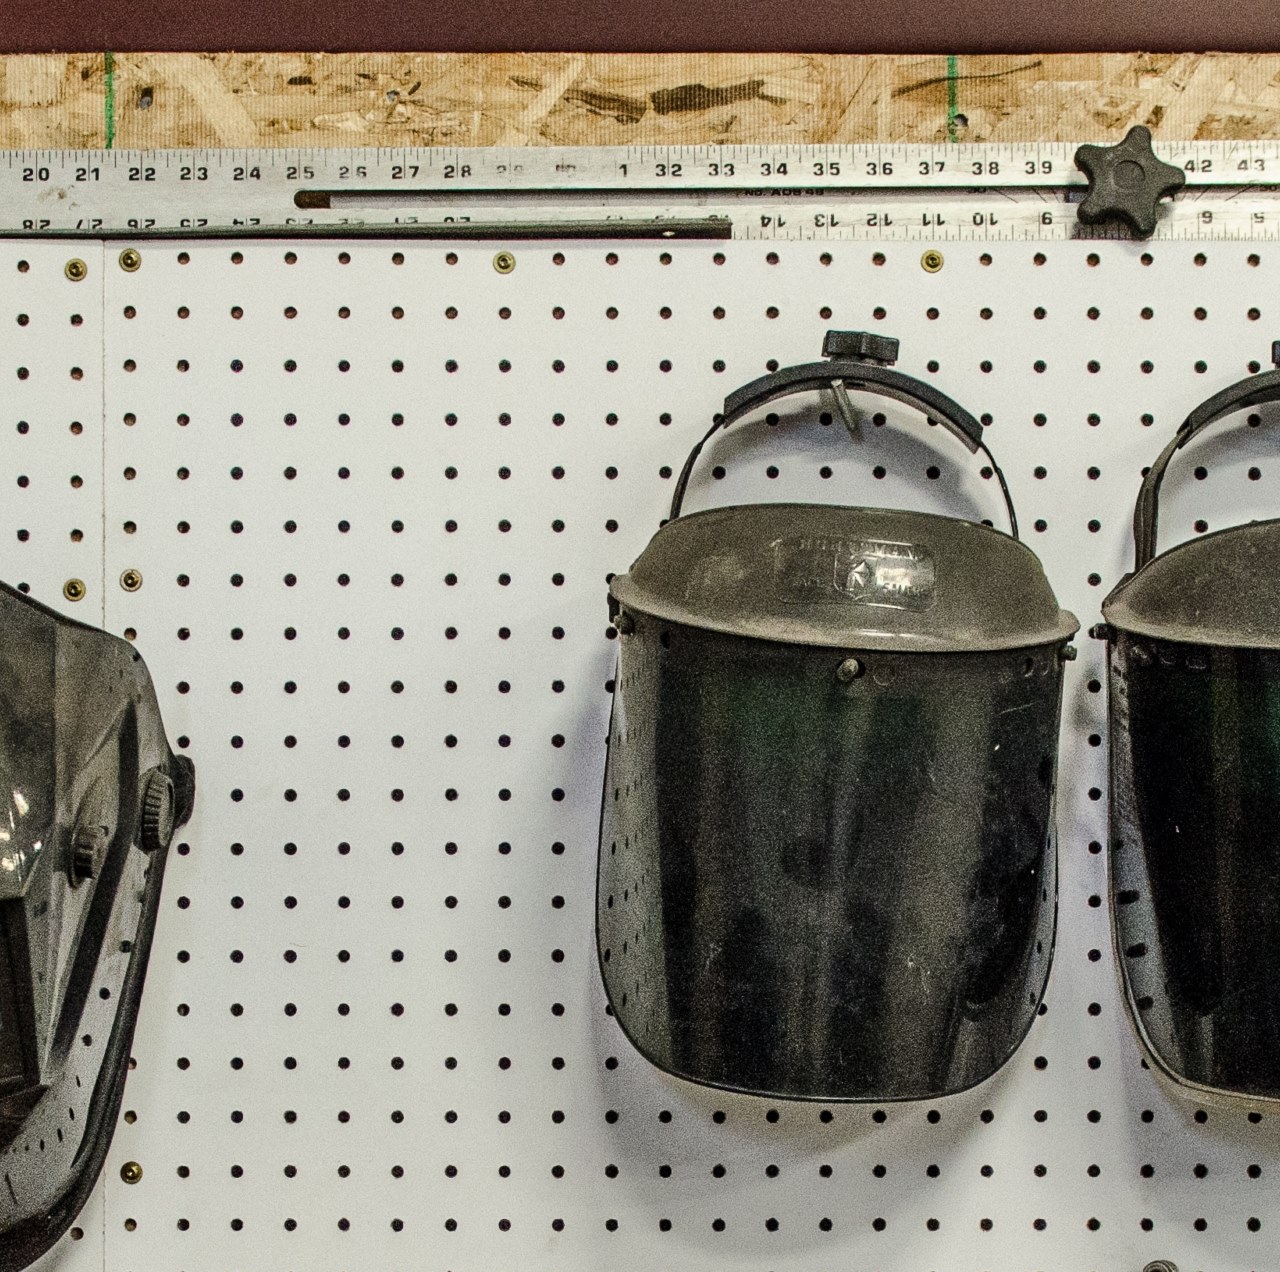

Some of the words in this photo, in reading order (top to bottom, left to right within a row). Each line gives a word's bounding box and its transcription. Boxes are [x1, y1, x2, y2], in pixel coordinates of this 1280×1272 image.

[22, 167, 50, 184] 20
[75, 166, 100, 183] 21
[128, 166, 156, 183] 22
[179, 166, 209, 183] 23
[233, 165, 261, 182] 24
[286, 165, 315, 182] 25
[339, 165, 368, 182] 26
[391, 164, 420, 181] 27
[443, 164, 472, 181] 28
[655, 161, 682, 178] 32
[708, 161, 735, 178] 33
[760, 160, 788, 177] 34
[813, 160, 841, 177] 35
[866, 160, 894, 177] 36
[918, 160, 946, 177] 37
[971, 159, 1000, 176] 38
[1025, 159, 1053, 176] 39
[1183, 157, 1213, 174] 42
[1236, 157, 1266, 174] 43
[760, 214, 786, 229] 14
[814, 214, 840, 229] 13
[866, 214, 893, 229] 12
[922, 213, 946, 228] 11
[972, 213, 998, 228] 10
